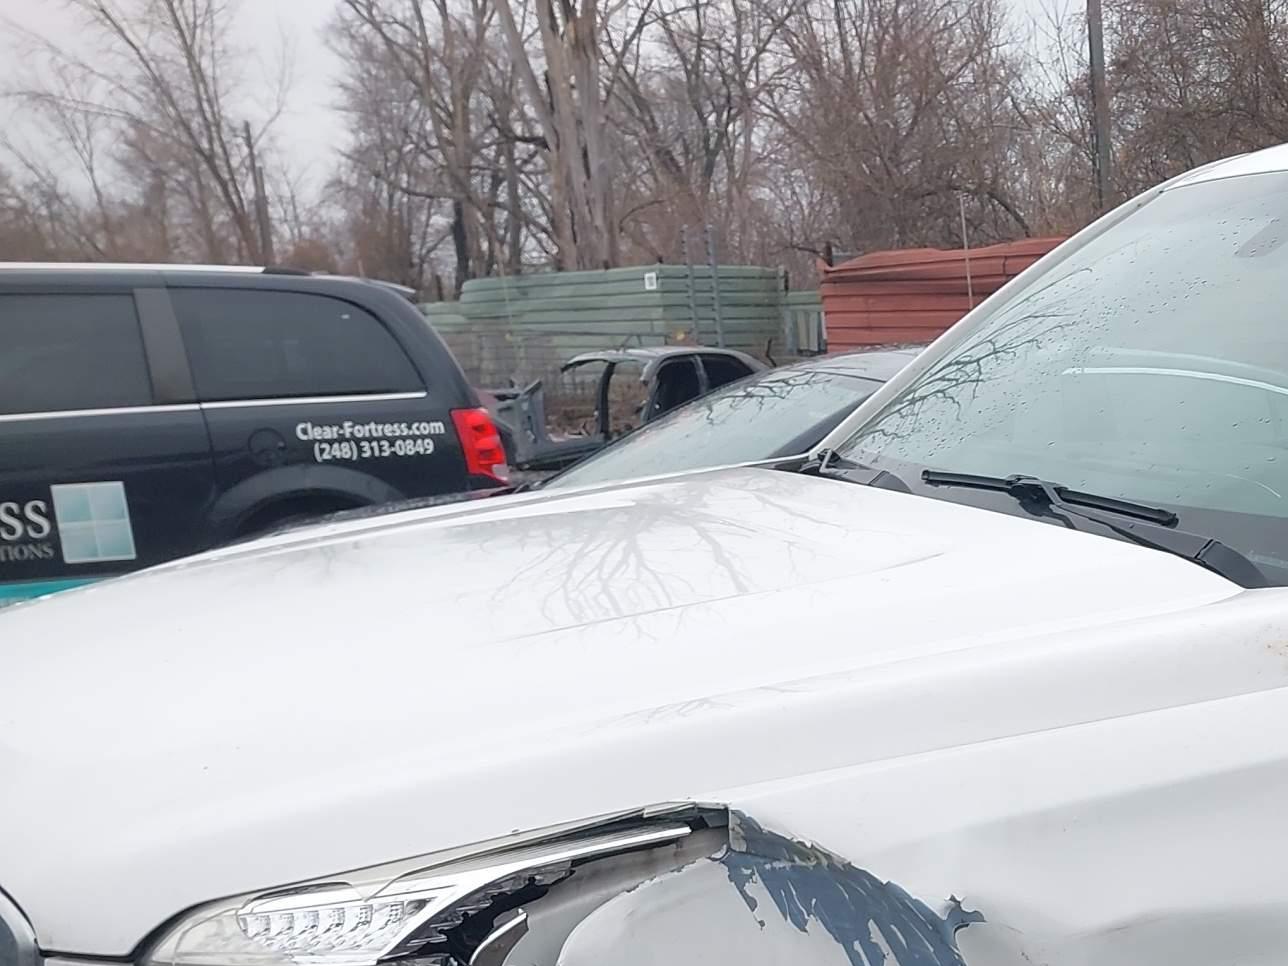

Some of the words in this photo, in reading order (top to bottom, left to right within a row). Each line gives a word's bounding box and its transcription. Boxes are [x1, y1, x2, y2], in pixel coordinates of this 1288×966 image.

[295, 421, 445, 441] Clear-Fortress.com
[314, 440, 358, 463] (248)
[359, 438, 435, 458] 313-0849
